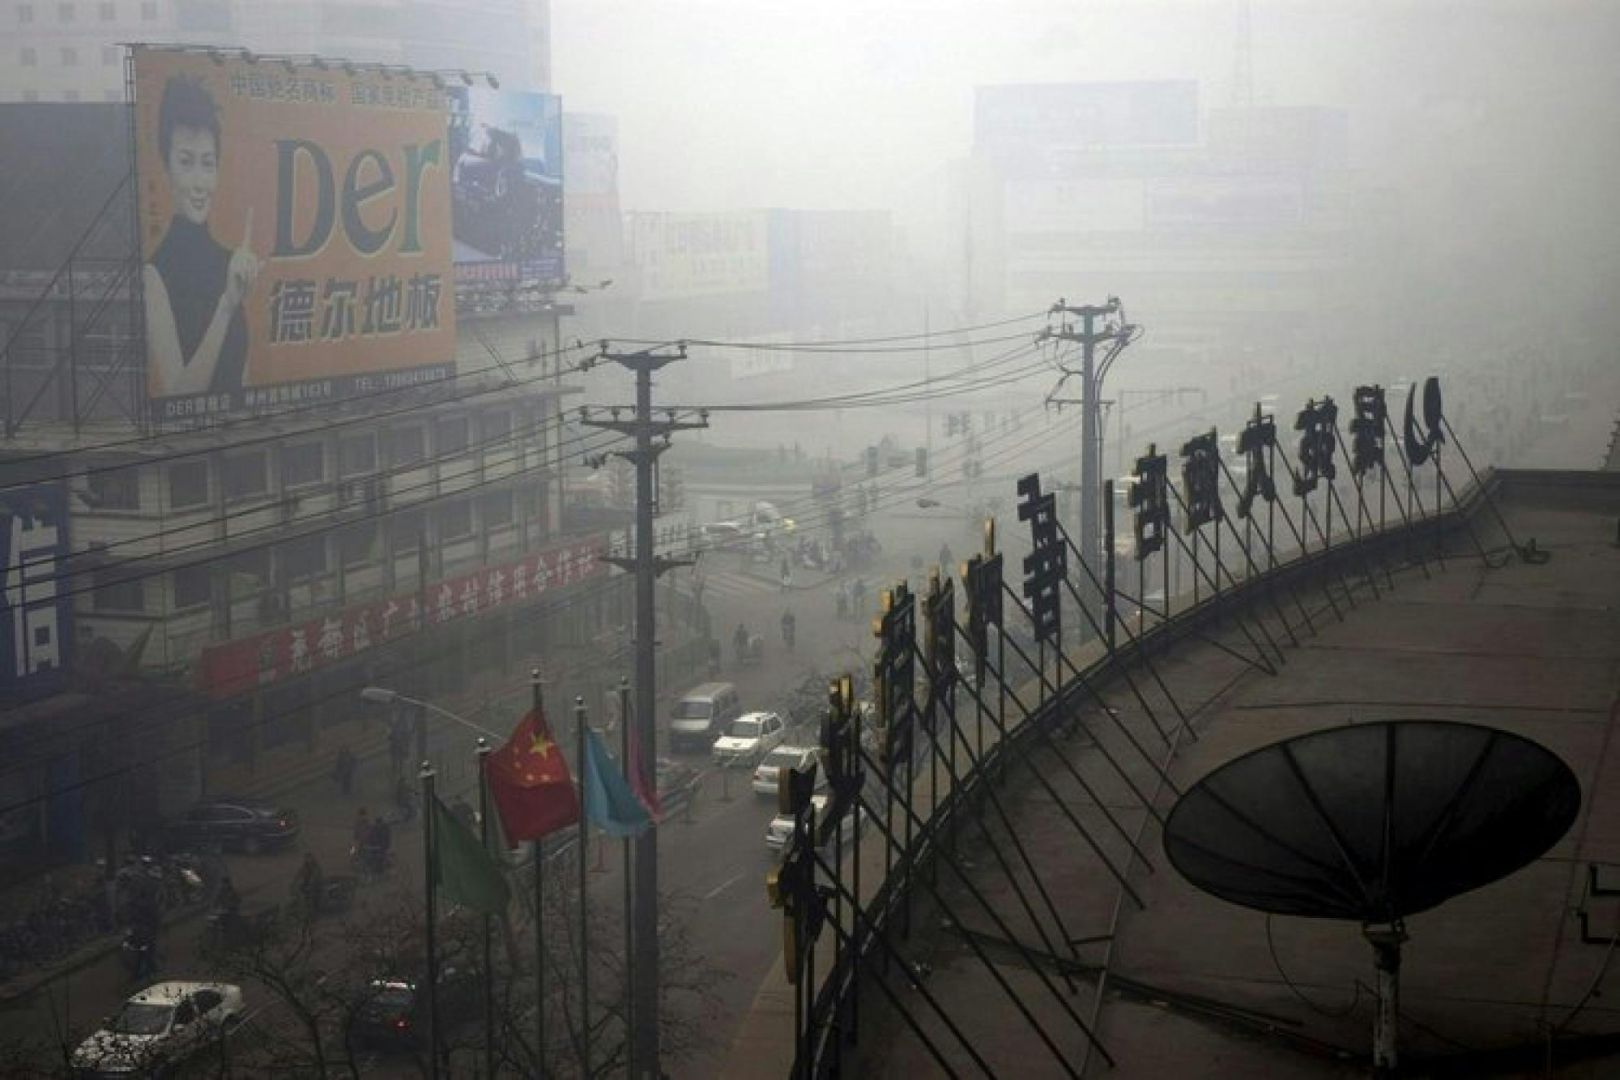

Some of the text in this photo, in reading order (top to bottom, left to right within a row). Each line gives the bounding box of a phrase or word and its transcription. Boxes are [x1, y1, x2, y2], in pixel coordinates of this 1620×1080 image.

[271, 139, 442, 257] Der
[270, 272, 441, 342] 德尔地板
